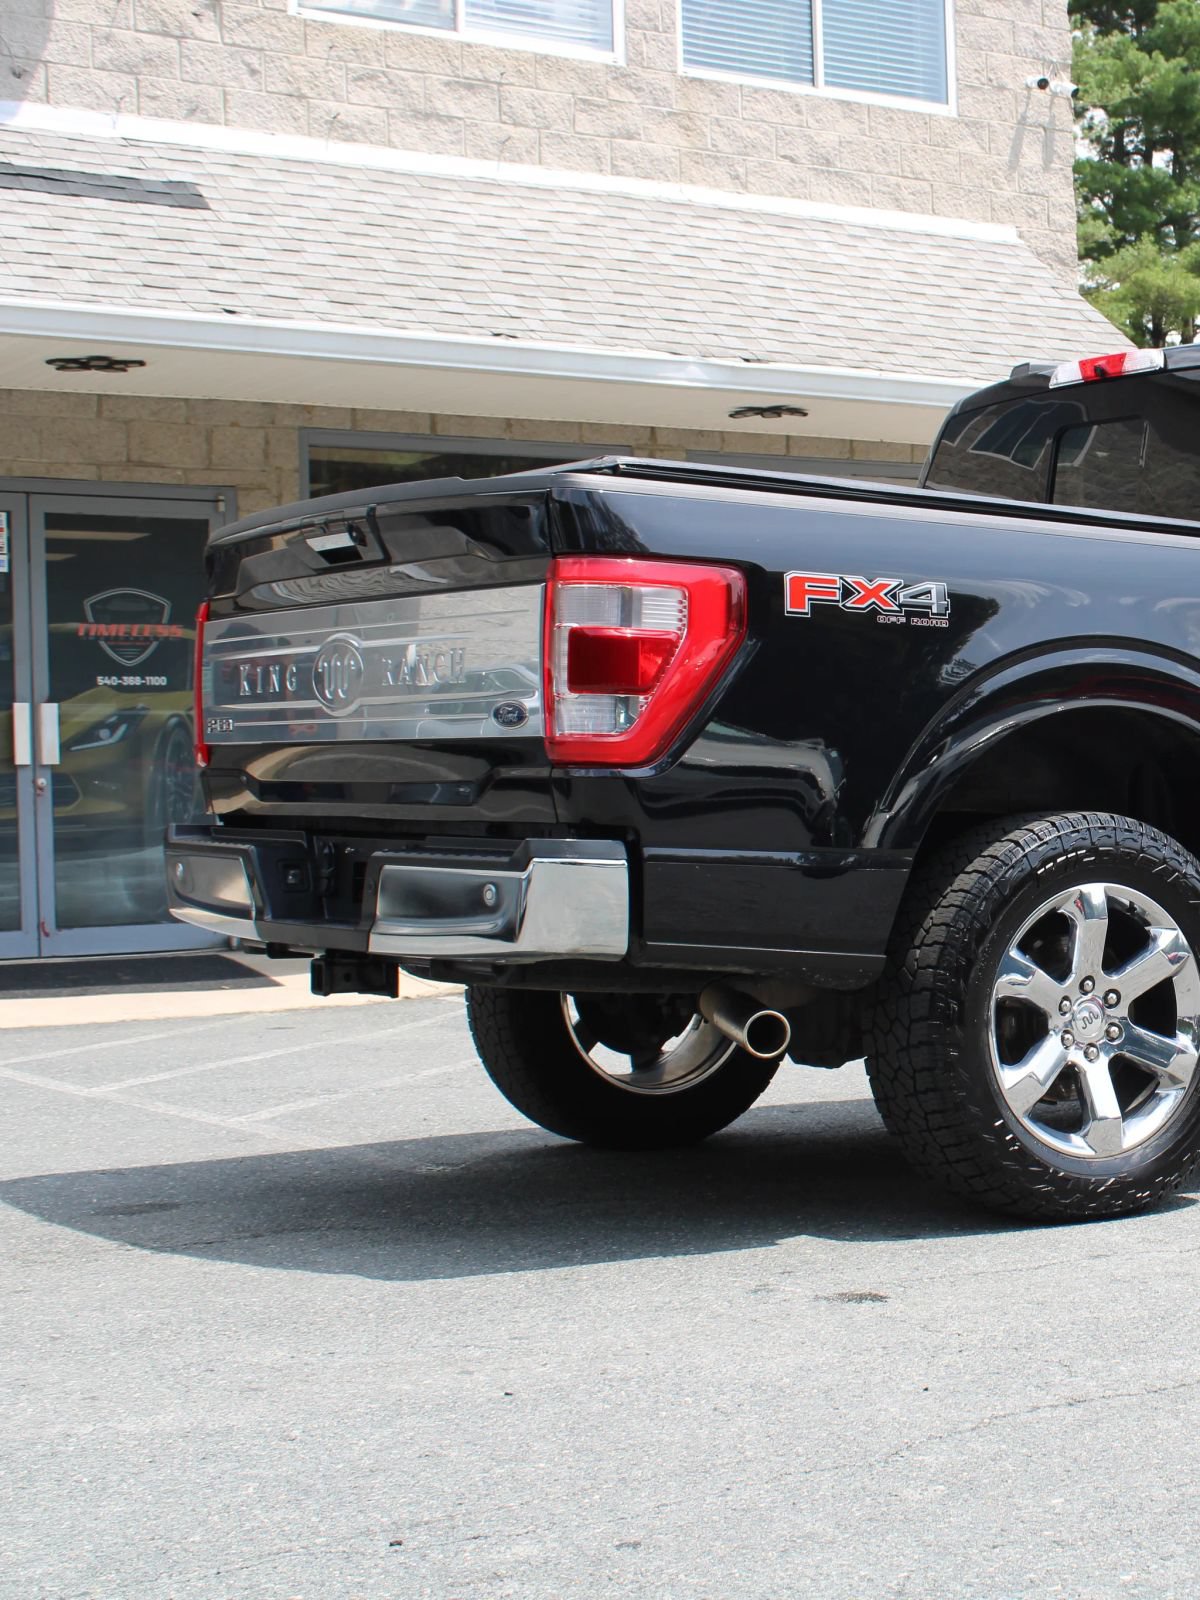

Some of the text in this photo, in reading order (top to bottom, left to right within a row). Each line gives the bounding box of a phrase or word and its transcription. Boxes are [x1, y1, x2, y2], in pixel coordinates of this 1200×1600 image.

[784, 570, 950, 617] FX4
[877, 615, 949, 627] OFF ROAD
[77, 623, 183, 637] TIMELESS
[239, 647, 467, 696] KING RANCH
[96, 676, 168, 686] 540-368-1100
[497, 706, 520, 724] Ford
